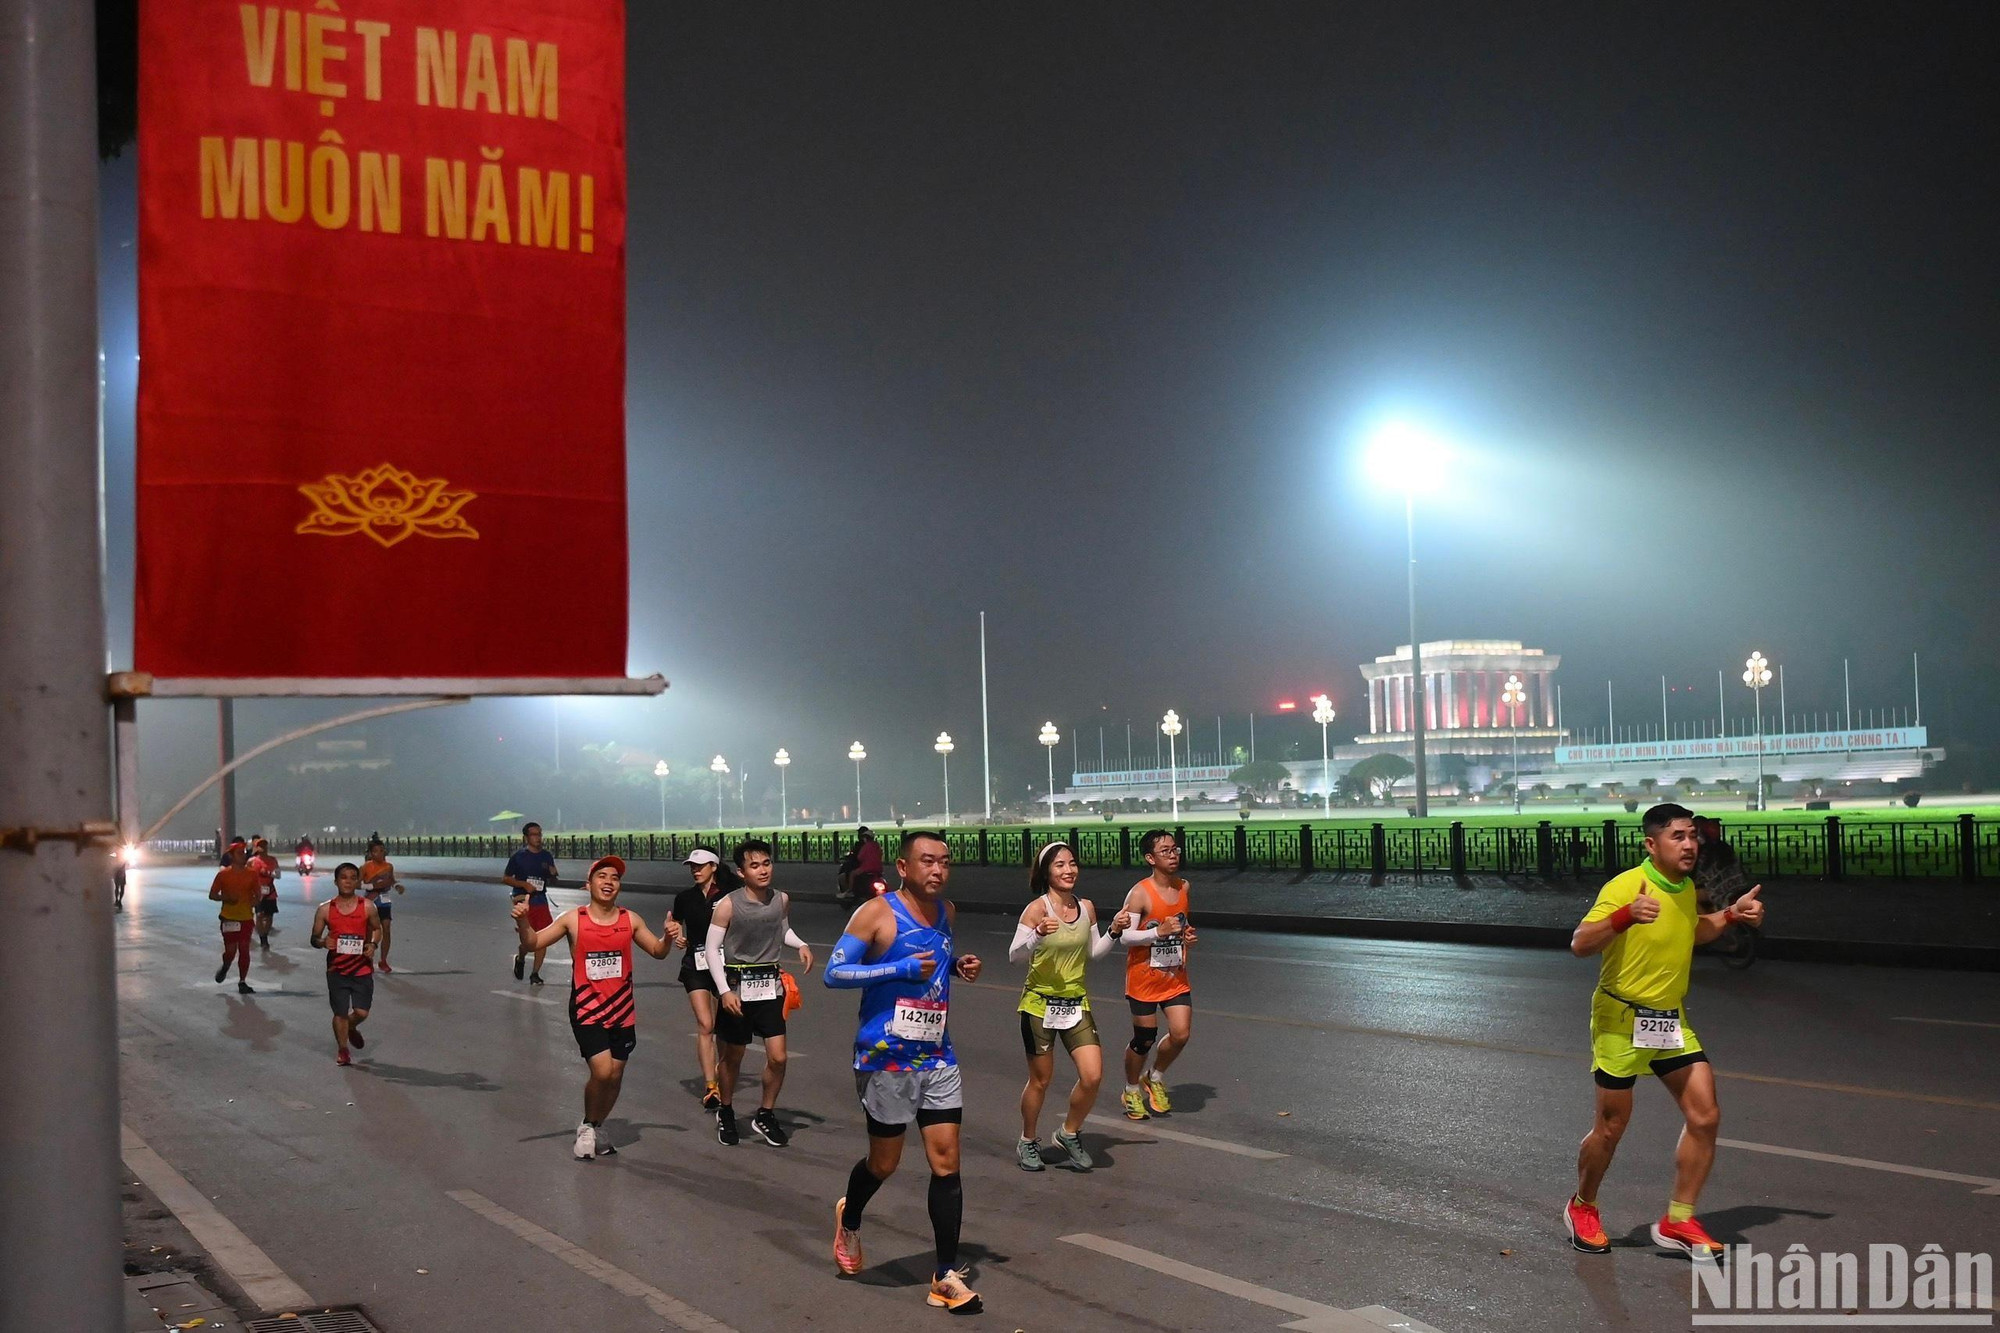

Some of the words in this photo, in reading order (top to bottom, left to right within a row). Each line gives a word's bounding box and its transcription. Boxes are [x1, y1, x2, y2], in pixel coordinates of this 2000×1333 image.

[240, 0, 391, 117] VIỆT
[416, 26, 559, 121] NAM
[201, 129, 401, 234] MUÔN
[426, 146, 594, 254] NĂM!
[1786, 735, 1820, 751] NGHIỆP
[1825, 731, 1844, 748] CỦA
[1847, 730, 1882, 747] CHÚNG
[1886, 732, 1899, 745] TA
[591, 957, 617, 967] 92802
[746, 980, 770, 988] 91738
[900, 1009, 942, 1024] 142149
[1640, 1019, 1675, 1032] 92126
